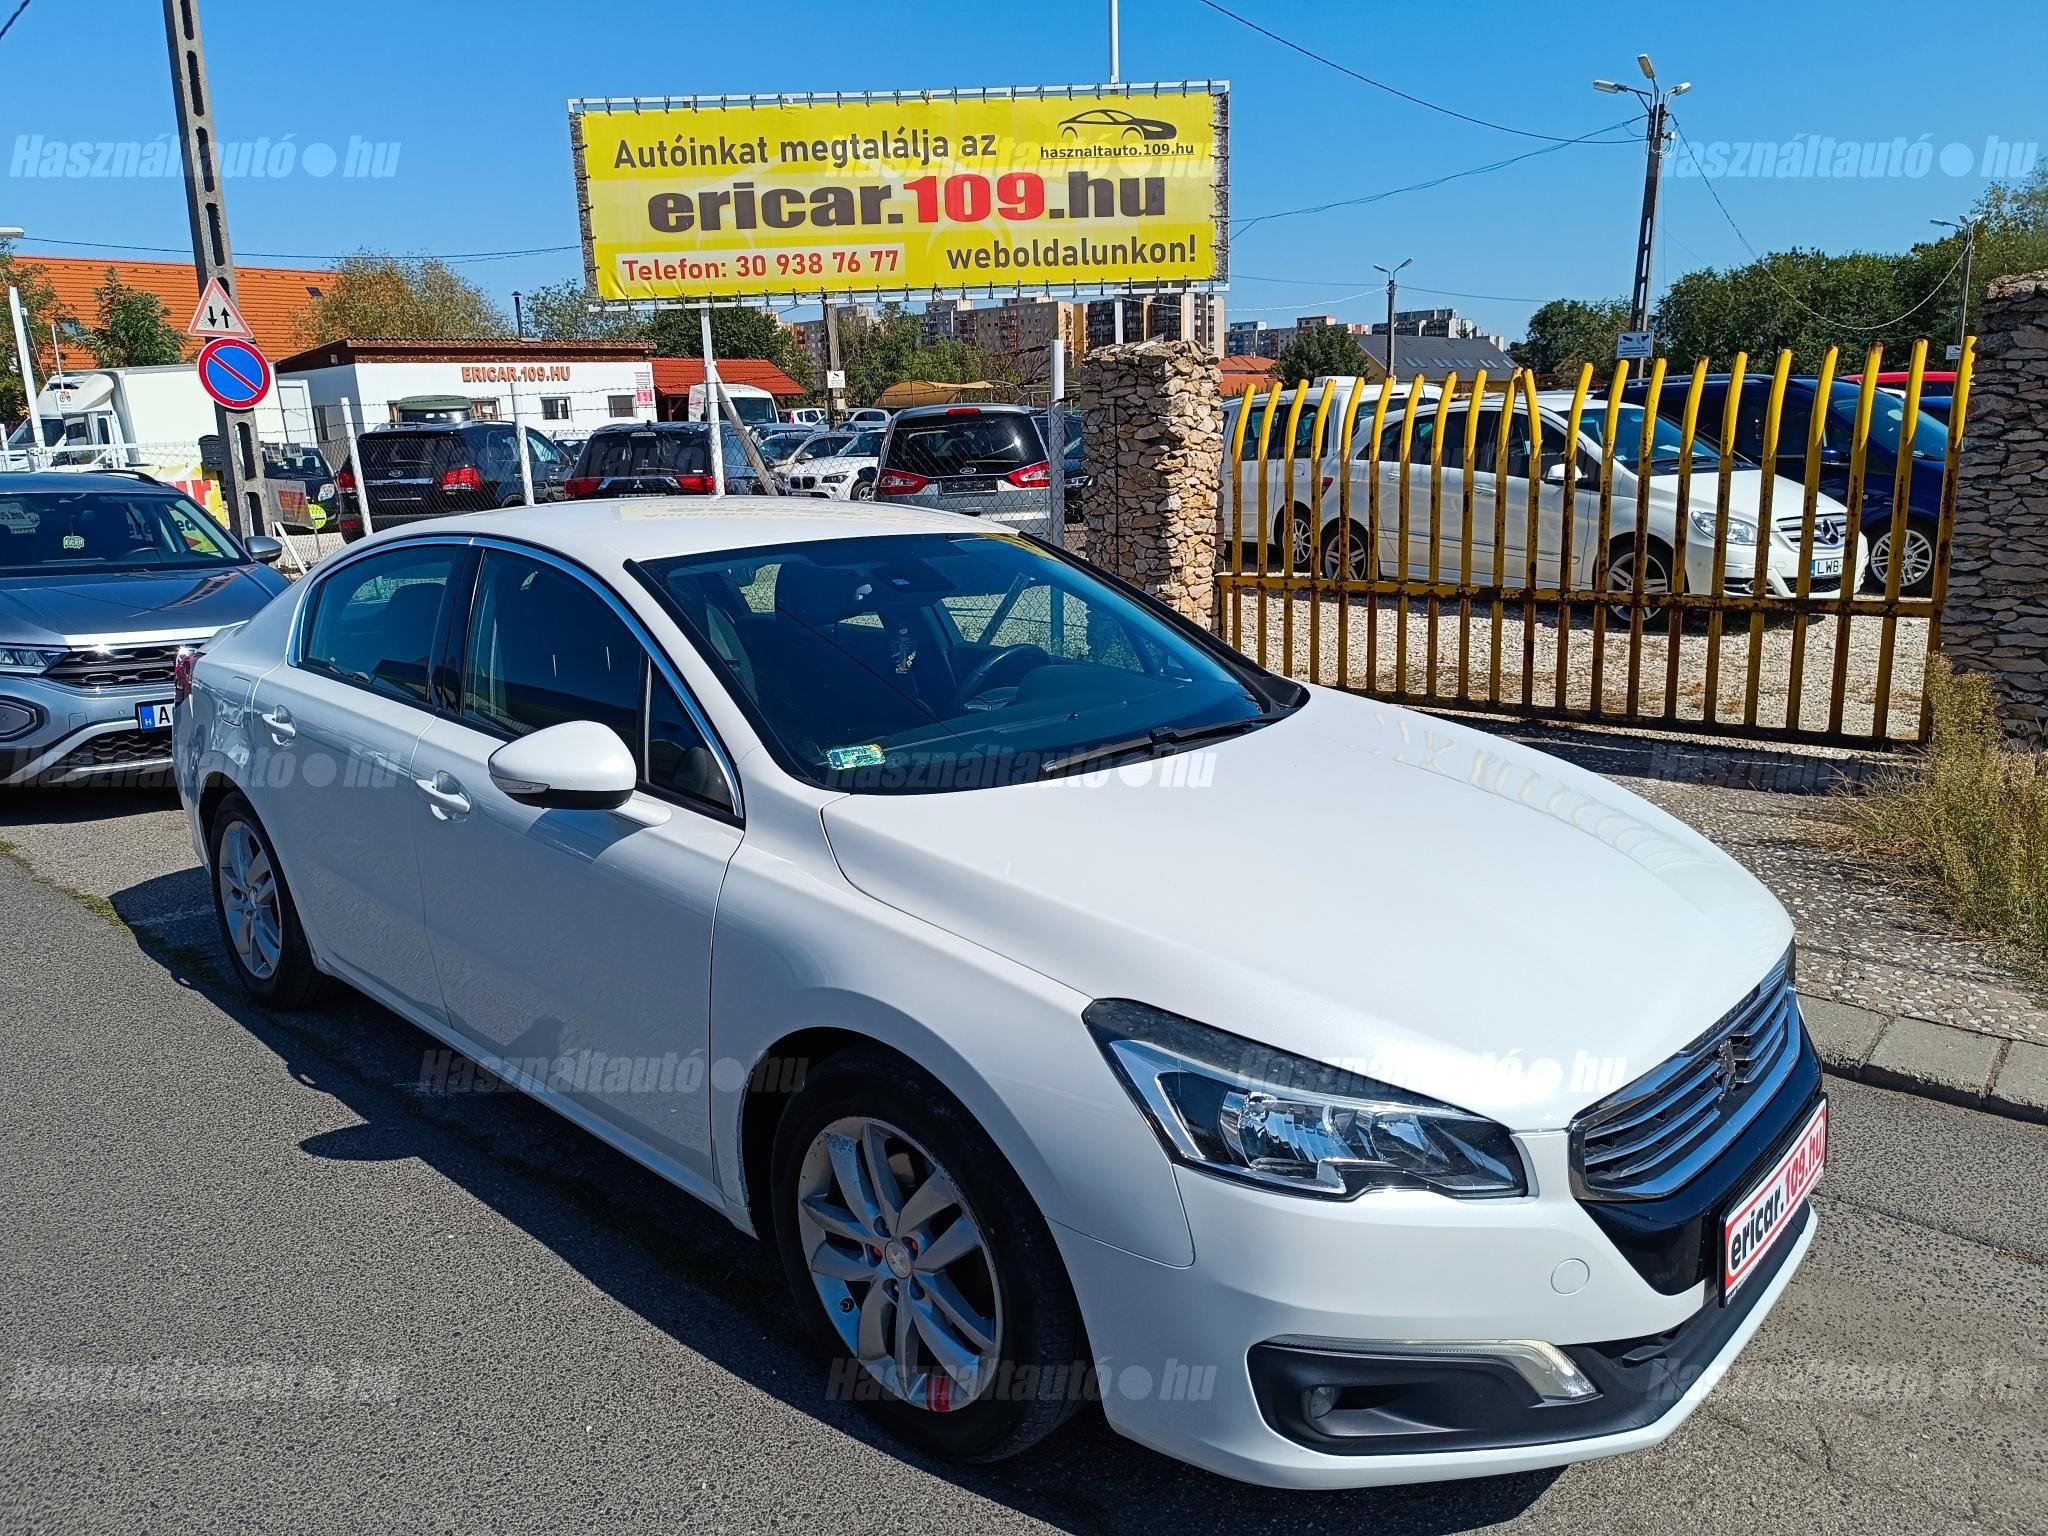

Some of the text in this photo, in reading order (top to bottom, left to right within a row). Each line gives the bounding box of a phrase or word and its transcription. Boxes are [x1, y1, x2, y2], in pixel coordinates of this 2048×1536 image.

[614, 126, 996, 169] Autóinkat megtalálja az
[1040, 143, 1194, 159] hasznaltauto.109.hu
[648, 171, 1166, 233] ericar.109.hu
[622, 250, 898, 282] Telefon: 30 938 76 77
[947, 234, 1196, 270] weboldalunkon!
[461, 366, 571, 383] ERICAR.109.HU
[1731, 1125, 1824, 1270] ericar.109.hu
